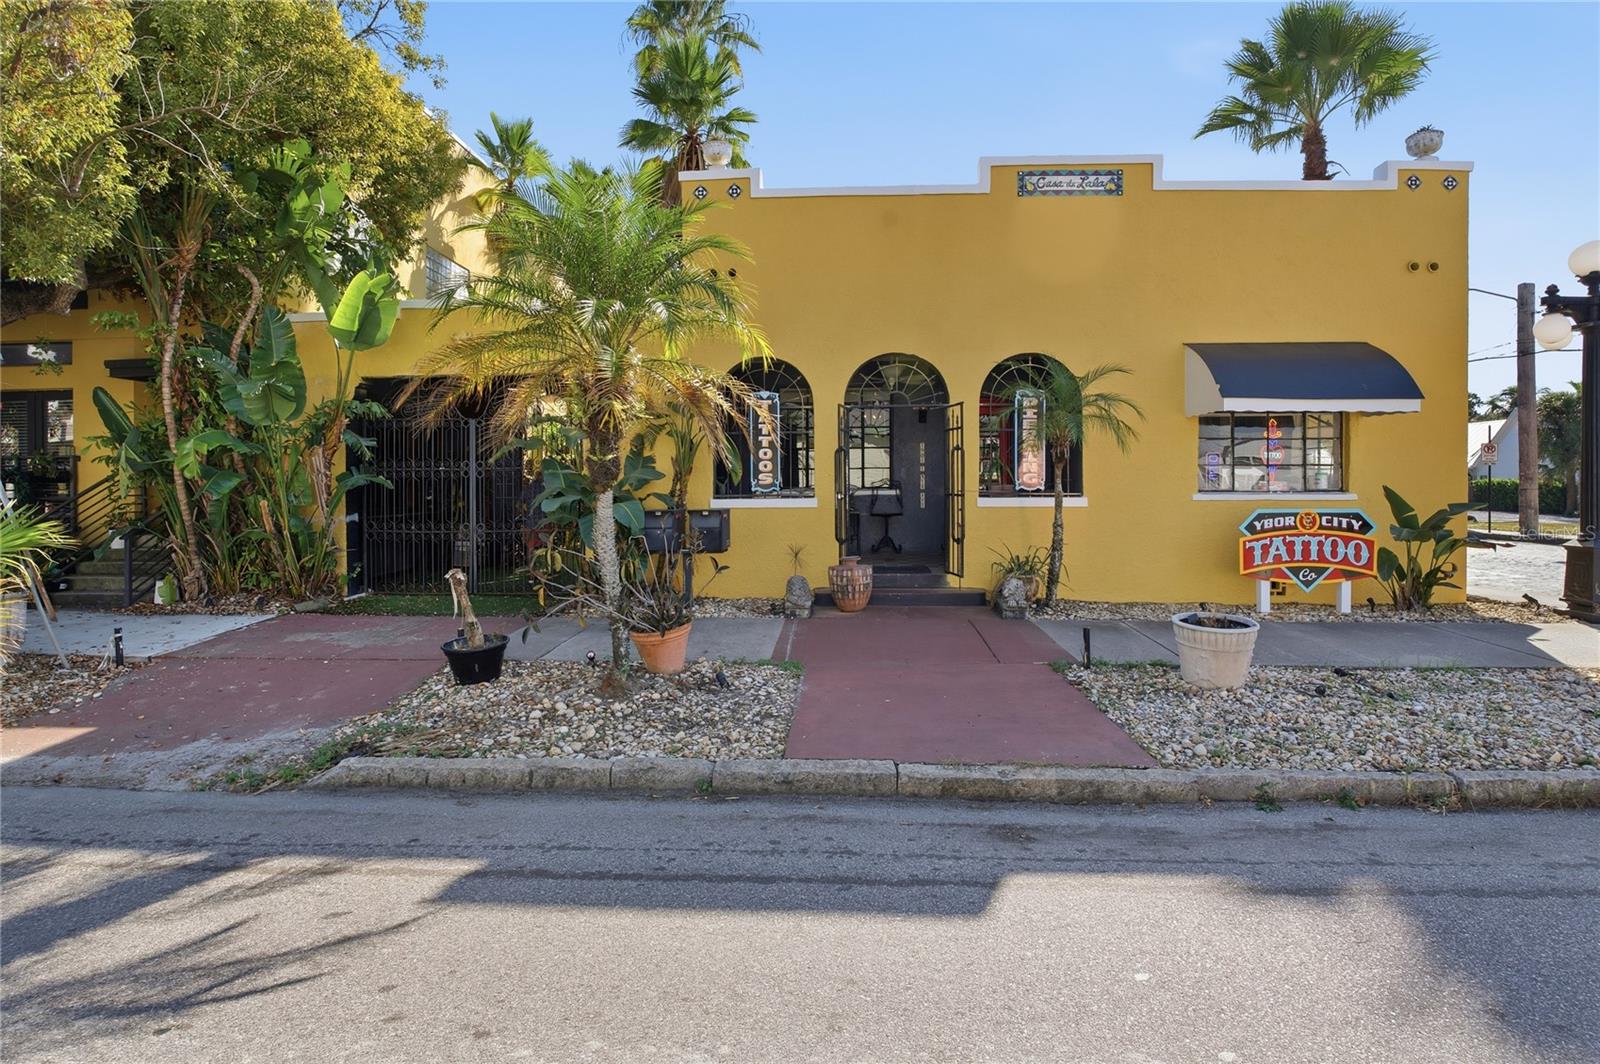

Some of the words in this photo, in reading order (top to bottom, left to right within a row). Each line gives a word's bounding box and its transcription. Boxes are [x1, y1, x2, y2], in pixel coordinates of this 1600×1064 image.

[1036, 177, 1063, 189] Casa
[758, 400, 773, 485] TTTOOS
[1021, 397, 1039, 484] PIERING
[1253, 515, 1296, 531] YBOR
[1321, 515, 1363, 531] CITY
[1245, 535, 1370, 566] TATTOO
[1299, 568, 1318, 581] Co
